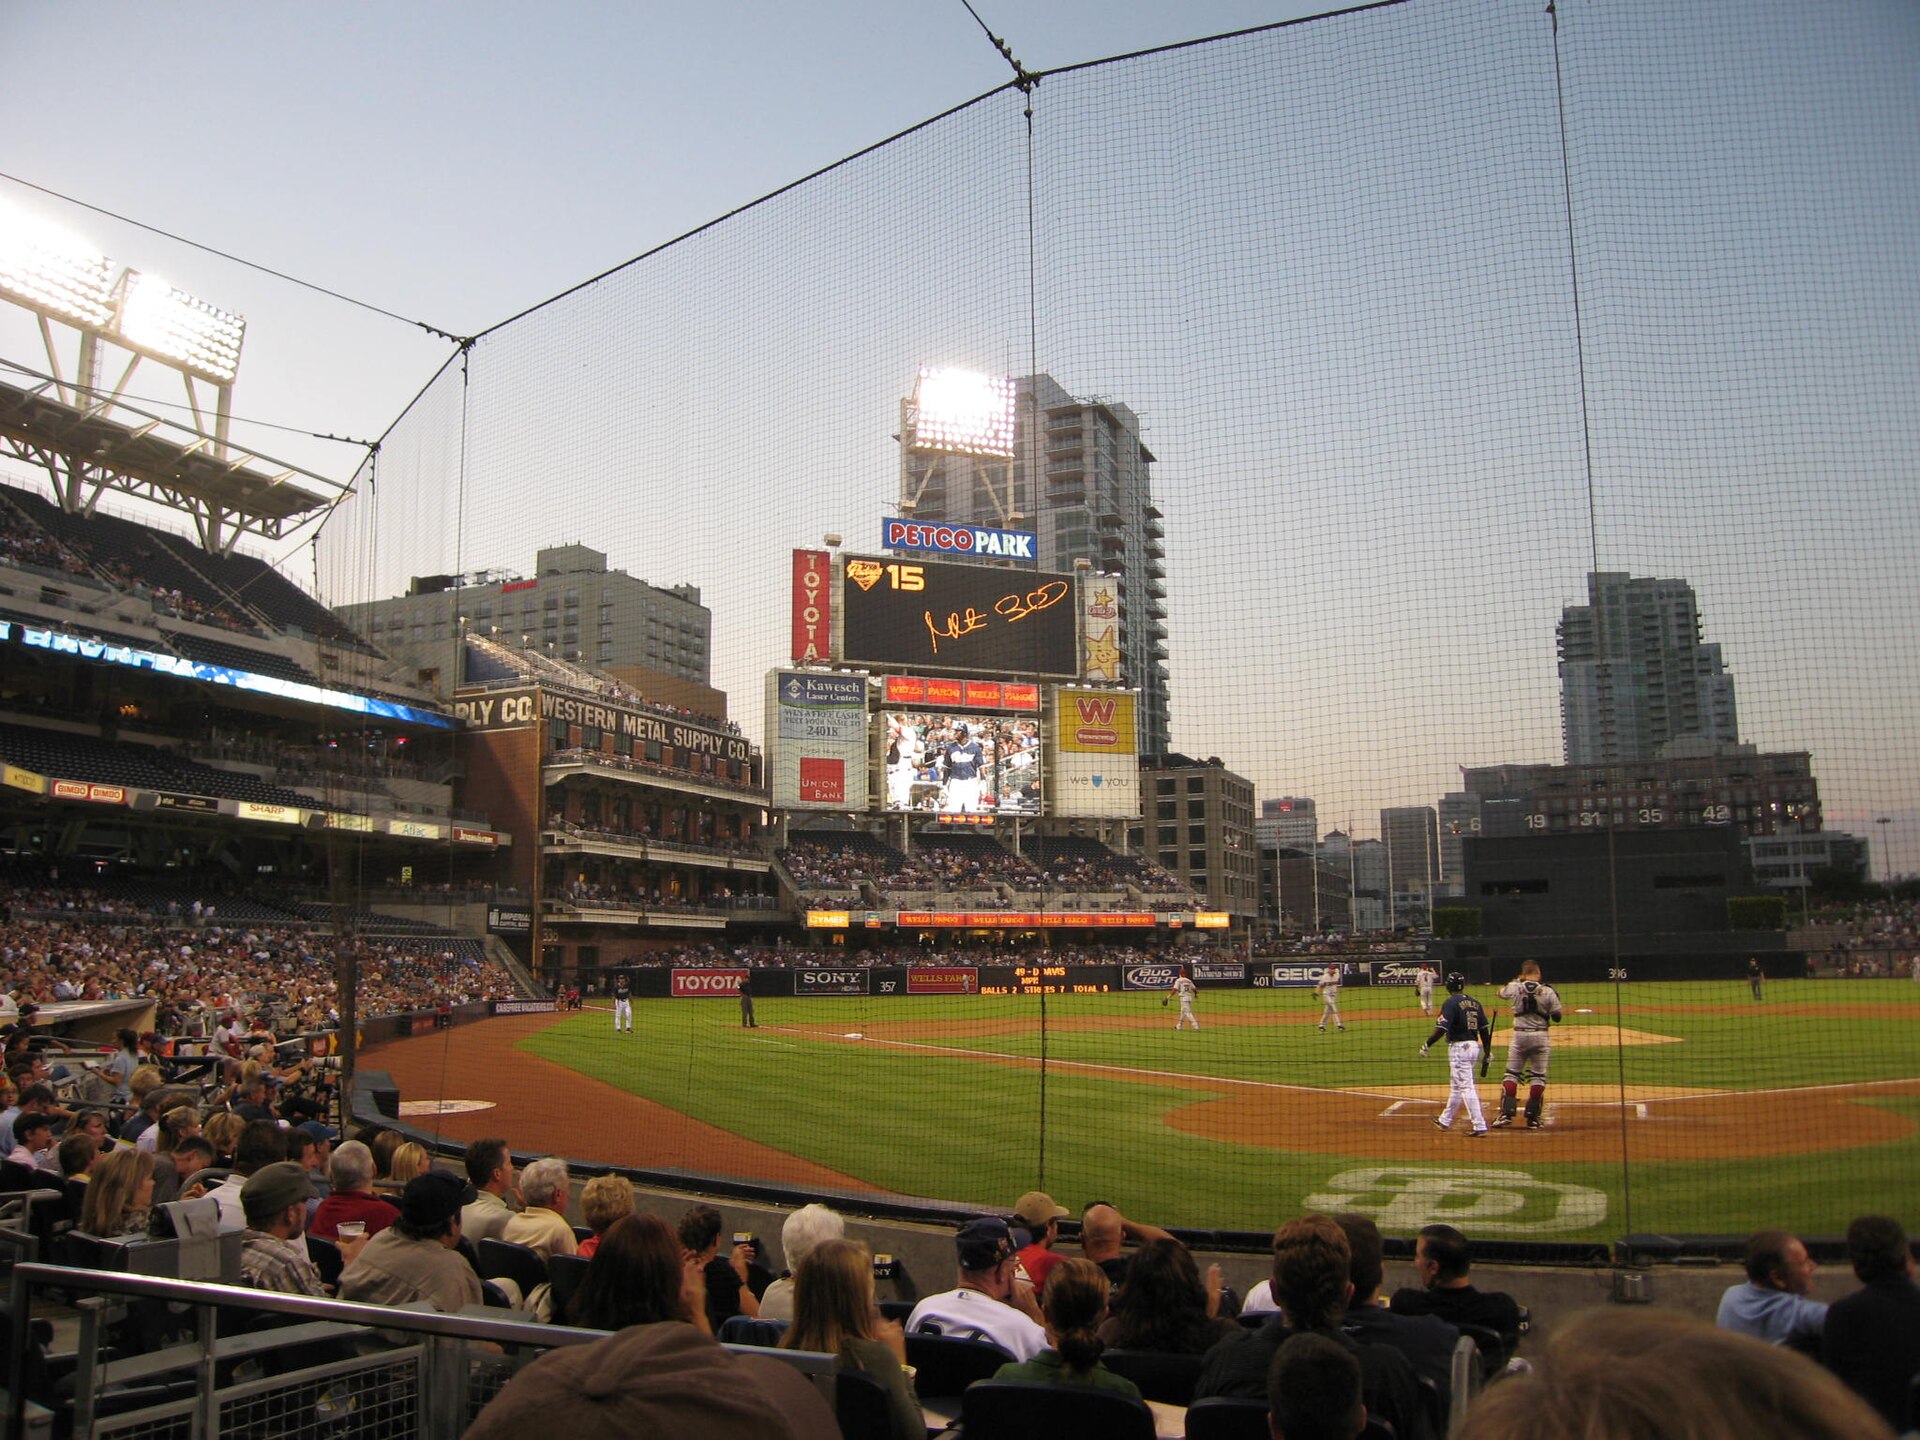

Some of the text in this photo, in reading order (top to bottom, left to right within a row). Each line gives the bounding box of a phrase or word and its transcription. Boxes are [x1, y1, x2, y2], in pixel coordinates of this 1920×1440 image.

[890, 523, 1032, 557] PETCO PARK
[886, 564, 925, 591] 15
[803, 555, 820, 659] TOYOTA
[806, 679, 860, 693] Kawesch
[890, 685, 960, 697] WELLS FARGO
[806, 692, 828, 701] Laser
[967, 690, 1036, 702] WELLS FARGO
[446, 696, 537, 728] PLY CO.
[1075, 697, 1116, 725] W
[542, 693, 749, 761] WESTERN METAL SUPPLY CO.
[807, 726, 838, 737] 24018
[801, 778, 838, 788] UNION
[1070, 776, 1129, 788] we you
[57, 783, 121, 799] BIMBO BIMBO
[815, 789, 842, 799] BANK
[250, 804, 285, 815] SHARP
[1638, 808, 1663, 823] 35
[1702, 805, 1727, 820] 42
[1470, 817, 1481, 831] 6
[1524, 814, 1546, 829] 19
[1580, 812, 1600, 827] 31
[803, 971, 861, 984] SONY
[910, 974, 975, 982] WELLS FARO
[1015, 967, 1026, 976] 49
[1033, 967, 1040, 976] D
[1378, 963, 1421, 980] Sycua
[676, 975, 743, 990] TOYOTA
[880, 981, 897, 992] 357
[1253, 976, 1270, 987] 401
[981, 986, 1008, 994] BALLS
[1012, 986, 1018, 994] 2
[1060, 985, 1065, 993] 7
[1073, 985, 1098, 993] TOTAL
[1103, 985, 1109, 993] 9
